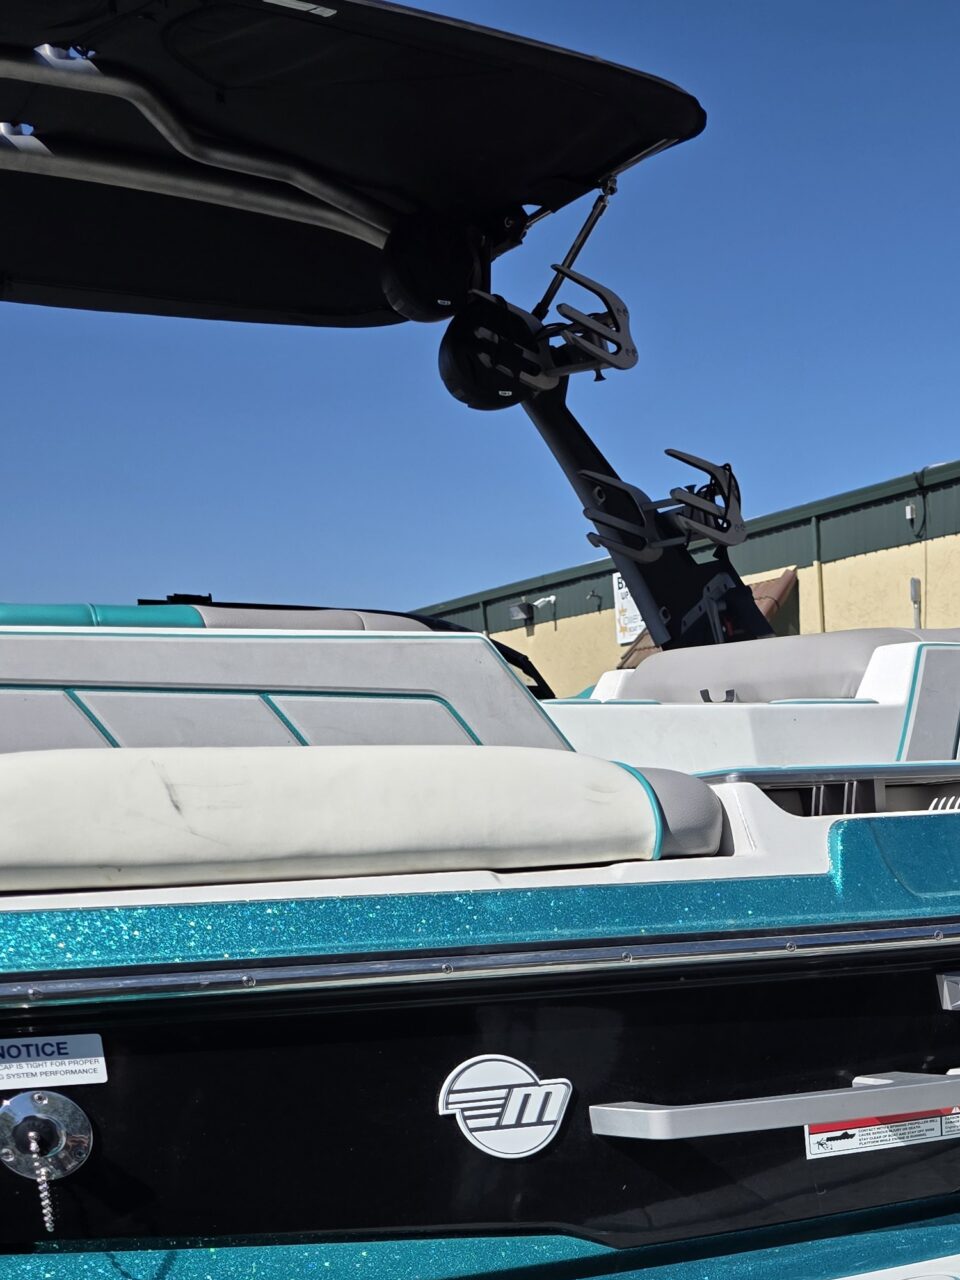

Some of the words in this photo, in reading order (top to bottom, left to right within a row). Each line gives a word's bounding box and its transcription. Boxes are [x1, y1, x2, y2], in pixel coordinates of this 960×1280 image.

[26, 1061, 49, 1069] TIGHT
[68, 1058, 100, 1066] PROPER
[6, 1071, 38, 1080] SYSTEM
[40, 1067, 98, 1077] PERFORMANCE
